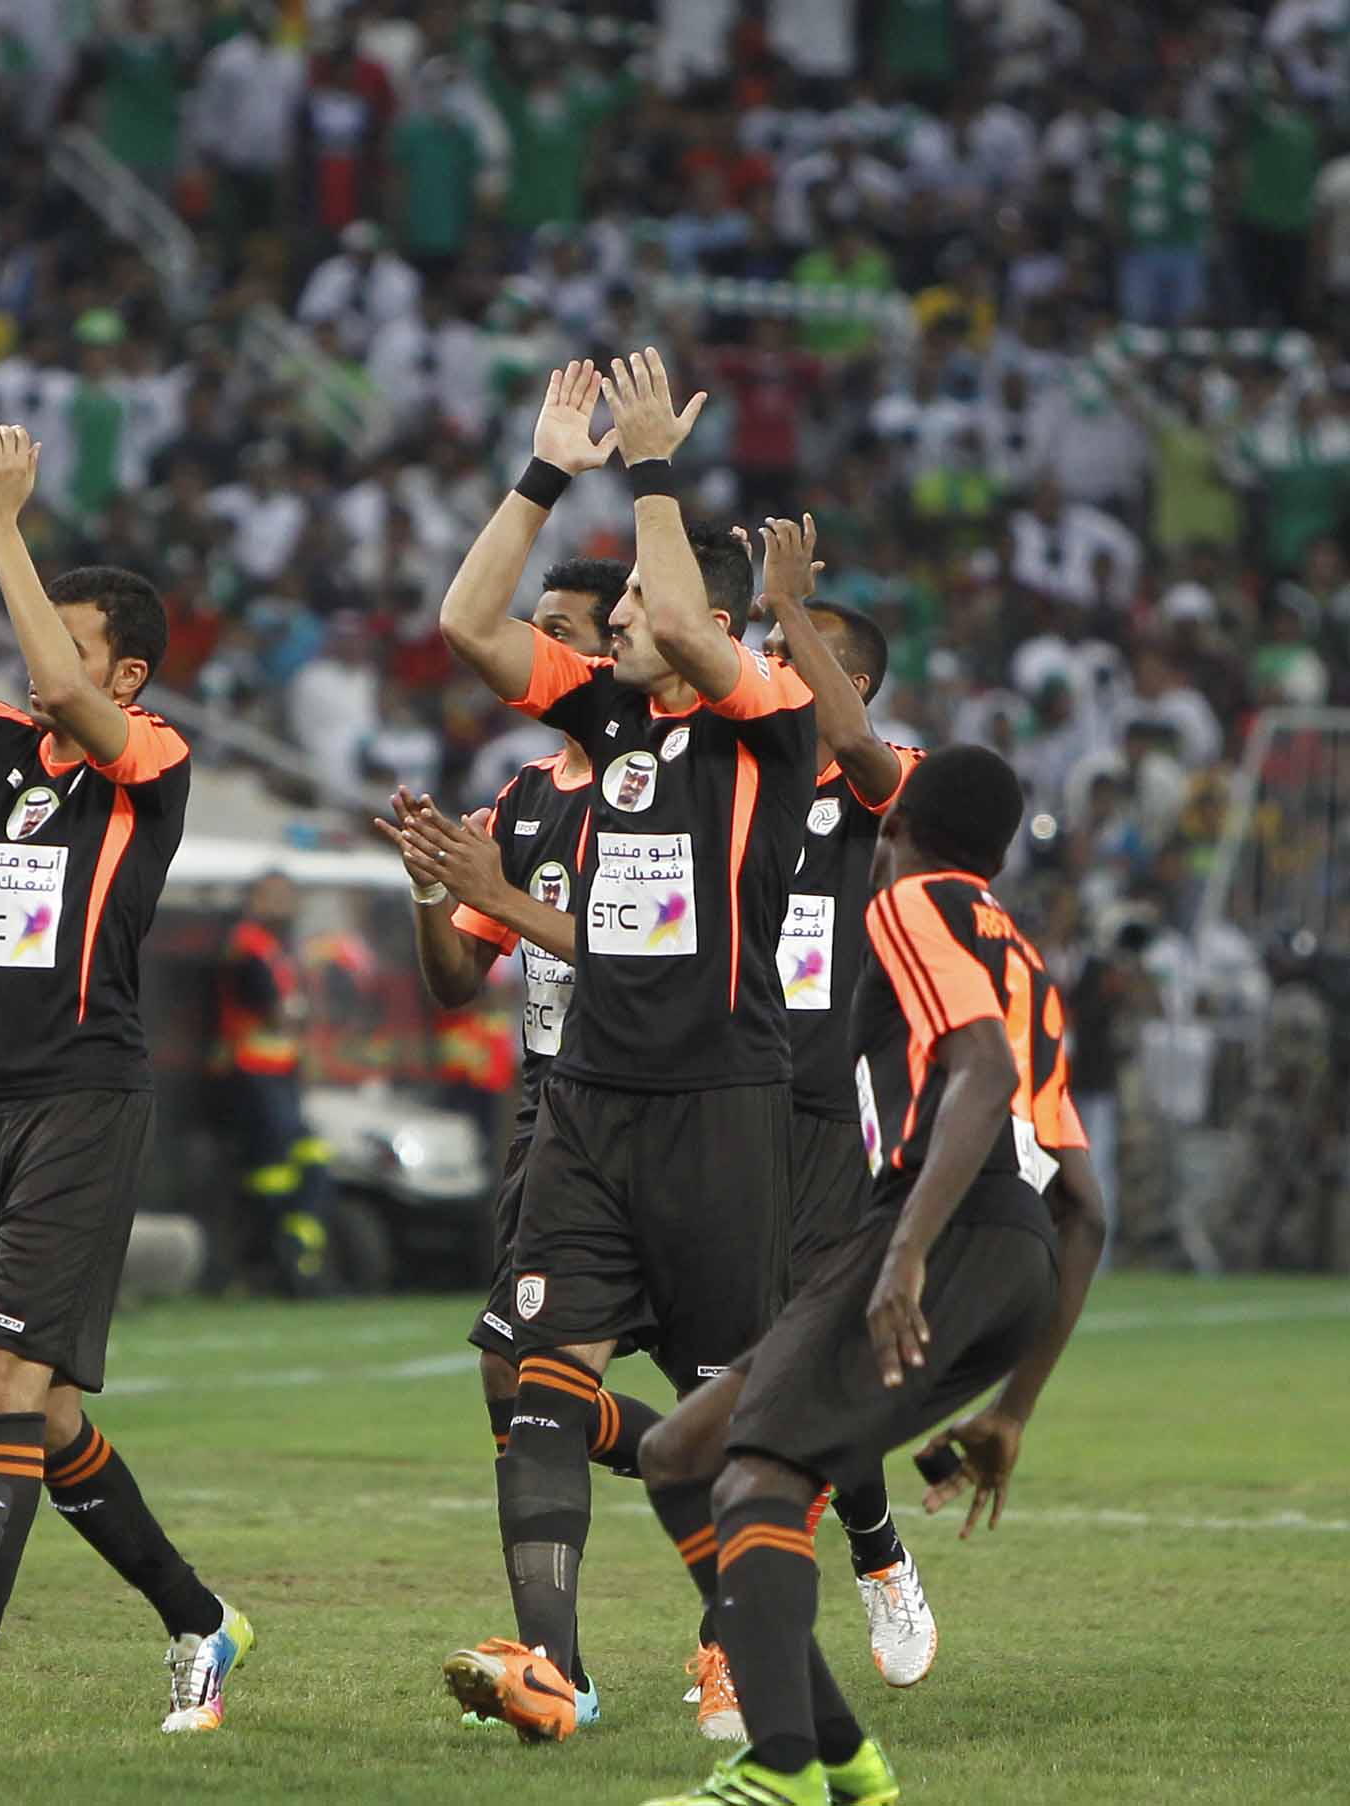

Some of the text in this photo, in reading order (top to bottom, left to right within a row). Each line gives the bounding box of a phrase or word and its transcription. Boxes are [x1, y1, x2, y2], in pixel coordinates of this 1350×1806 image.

[27, 849, 62, 873] أبو
[648, 836, 683, 862] أبو
[623, 862, 684, 886] شعبك
[592, 902, 639, 930] STC
[793, 898, 827, 921] أبو
[780, 923, 825, 941] شعب
[525, 1001, 554, 1031] STC
